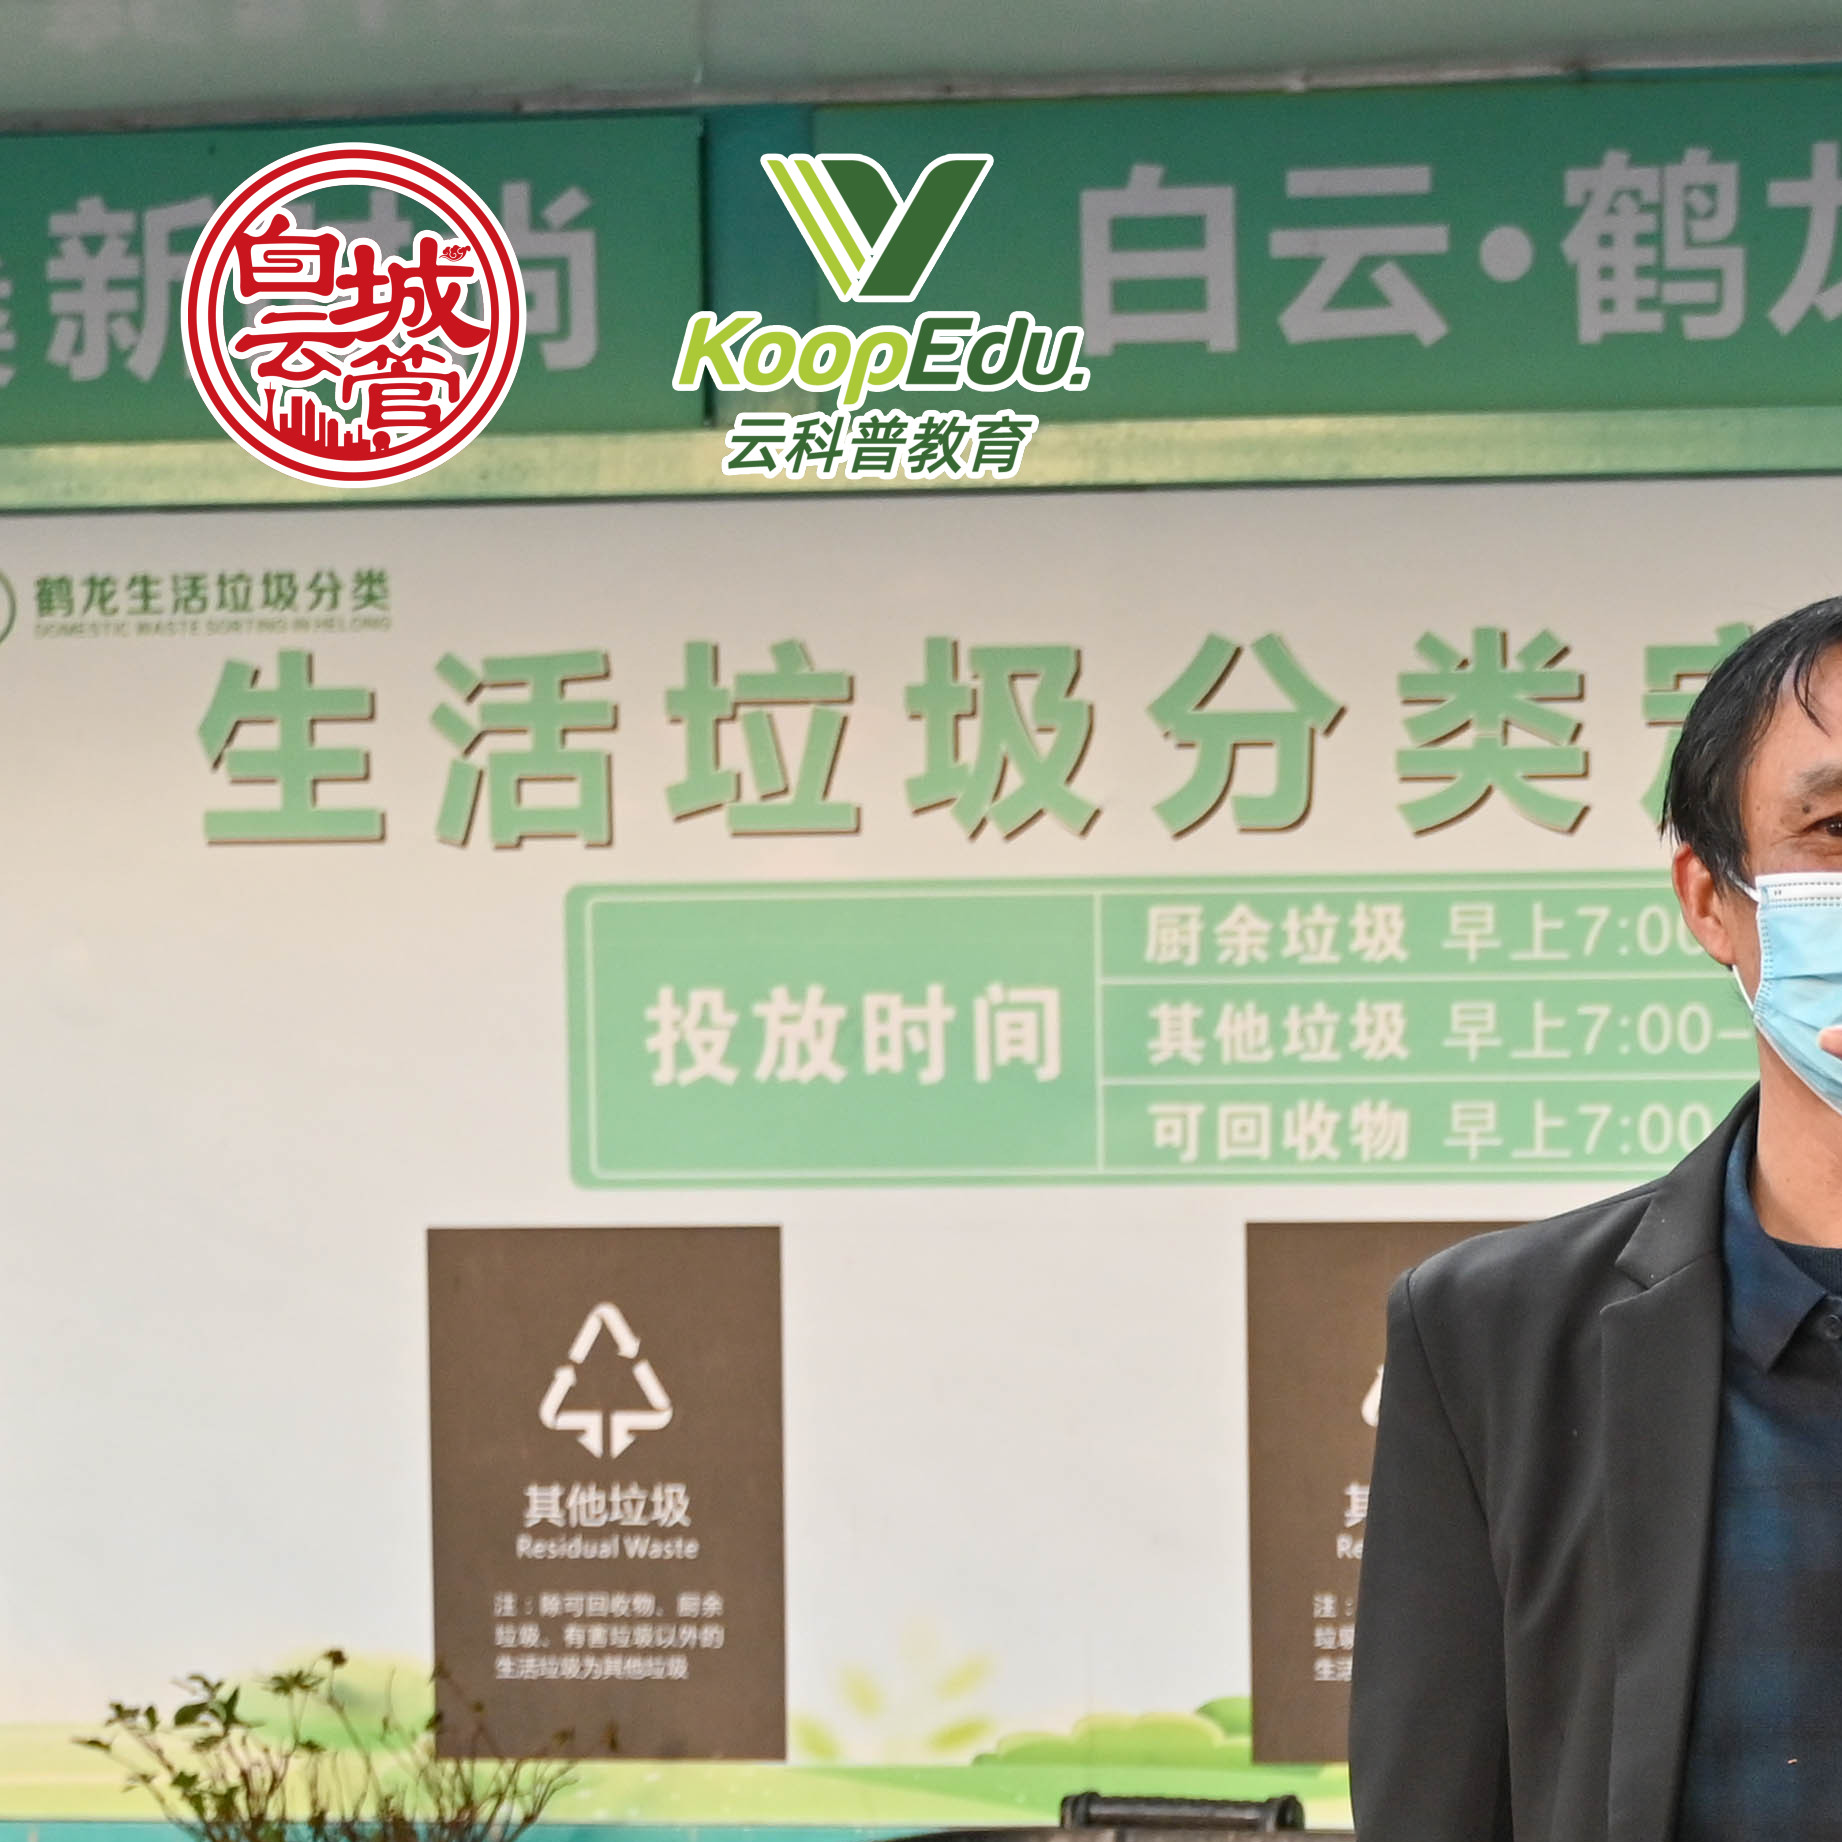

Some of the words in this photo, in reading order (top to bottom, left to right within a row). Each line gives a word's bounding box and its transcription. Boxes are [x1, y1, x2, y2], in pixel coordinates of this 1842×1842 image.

[34, 567, 390, 618] 鹤龙生活垃圾分类
[1145, 901, 1406, 966] 厨余垃圾
[643, 983, 1064, 1087] 投放时间
[1146, 1001, 1408, 1065] 其他垃圾
[1147, 1099, 1408, 1162] 可回收物
[524, 1482, 691, 1528] 其他垃圾
[516, 1534, 619, 1560] Residual
[622, 1534, 700, 1560] Waste
